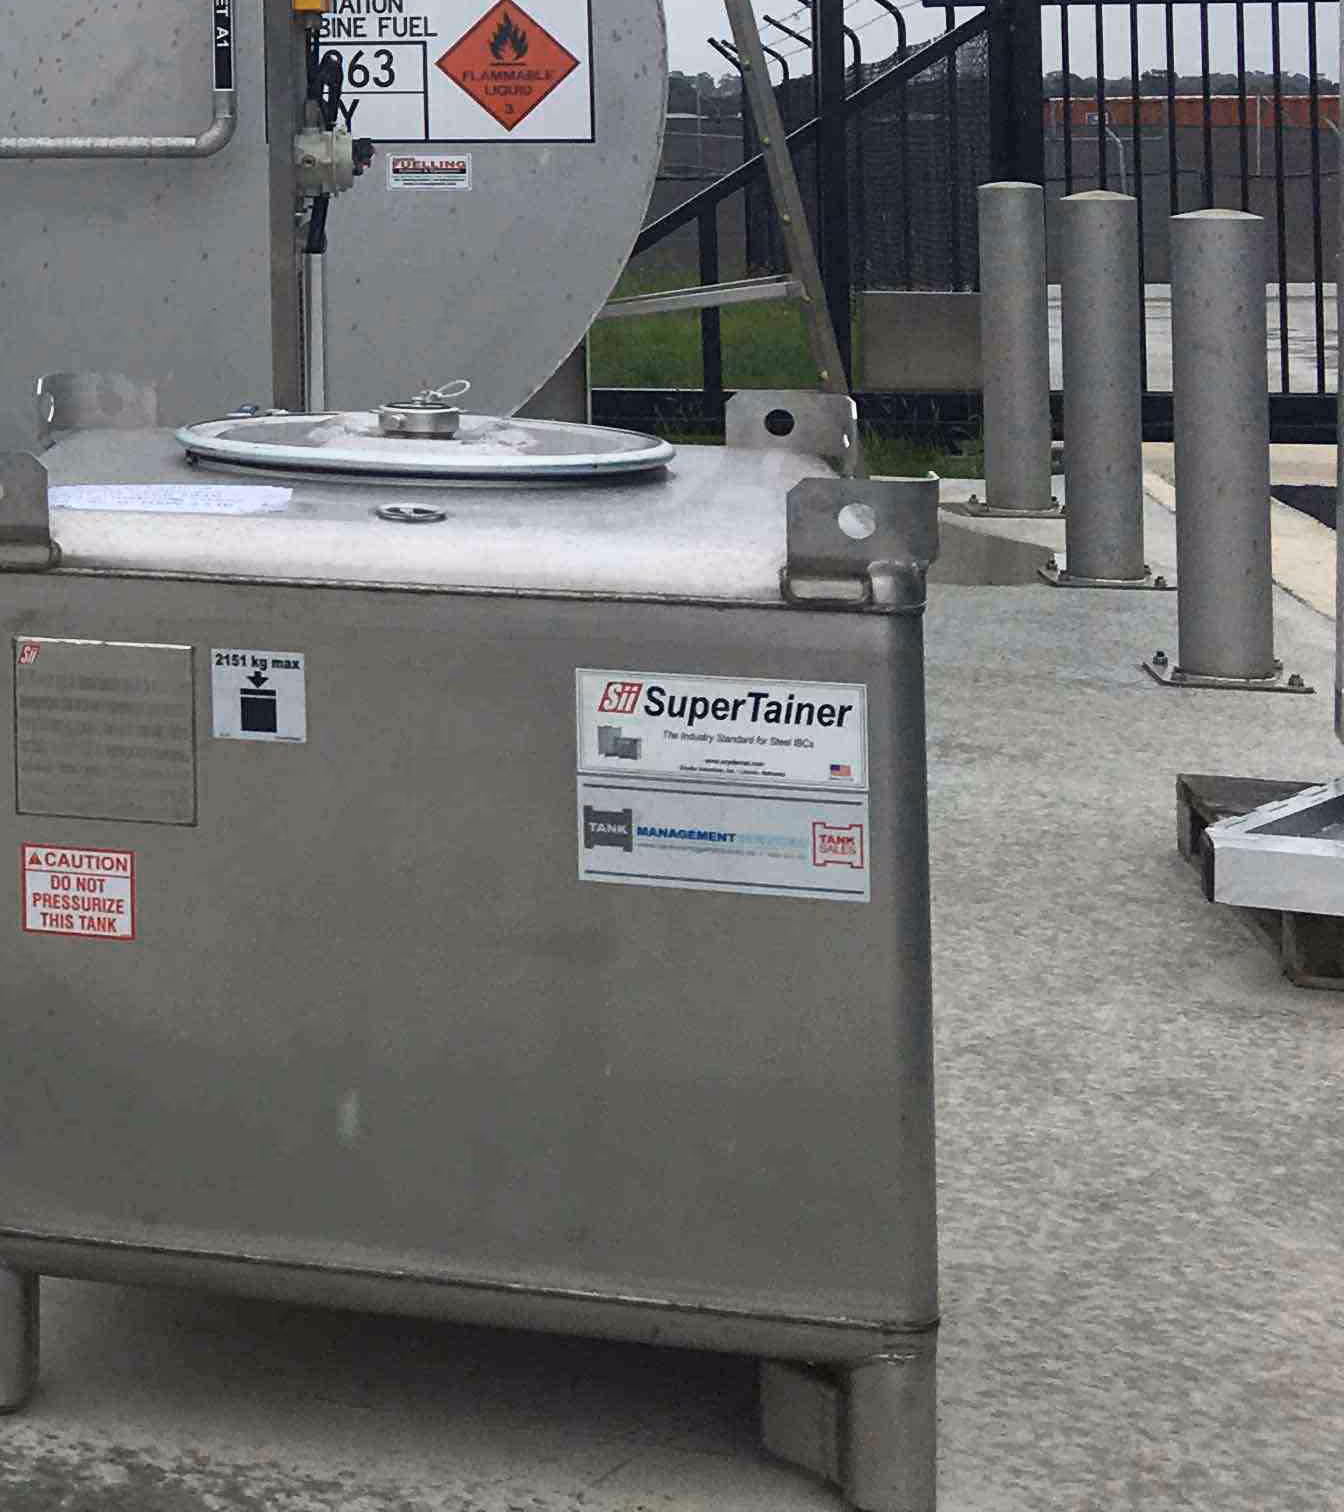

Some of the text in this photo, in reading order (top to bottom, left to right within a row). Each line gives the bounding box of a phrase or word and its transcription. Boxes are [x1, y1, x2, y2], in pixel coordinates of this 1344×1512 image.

[216, 27, 229, 47] A1
[318, 16, 438, 38] BINE FUEL
[463, 70, 554, 81] FLAMMABLE
[484, 85, 532, 96] LIQUID
[338, 98, 360, 133] Y
[214, 653, 300, 671] 2151 kg max
[603, 682, 853, 727] Sii SuperTainer
[664, 730, 678, 740] The
[681, 732, 713, 744] Industry
[716, 733, 754, 744] Standard
[756, 735, 768, 745] for
[770, 736, 792, 746] Steel
[589, 822, 628, 834] TANK
[636, 826, 736, 842] MANAGEMENT
[819, 834, 855, 845] TANK
[44, 852, 128, 872] CAUTION
[50, 875, 105, 893] DO NOT
[32, 892, 124, 915] PRESSURIZE
[40, 912, 117, 933] THIS TANK
